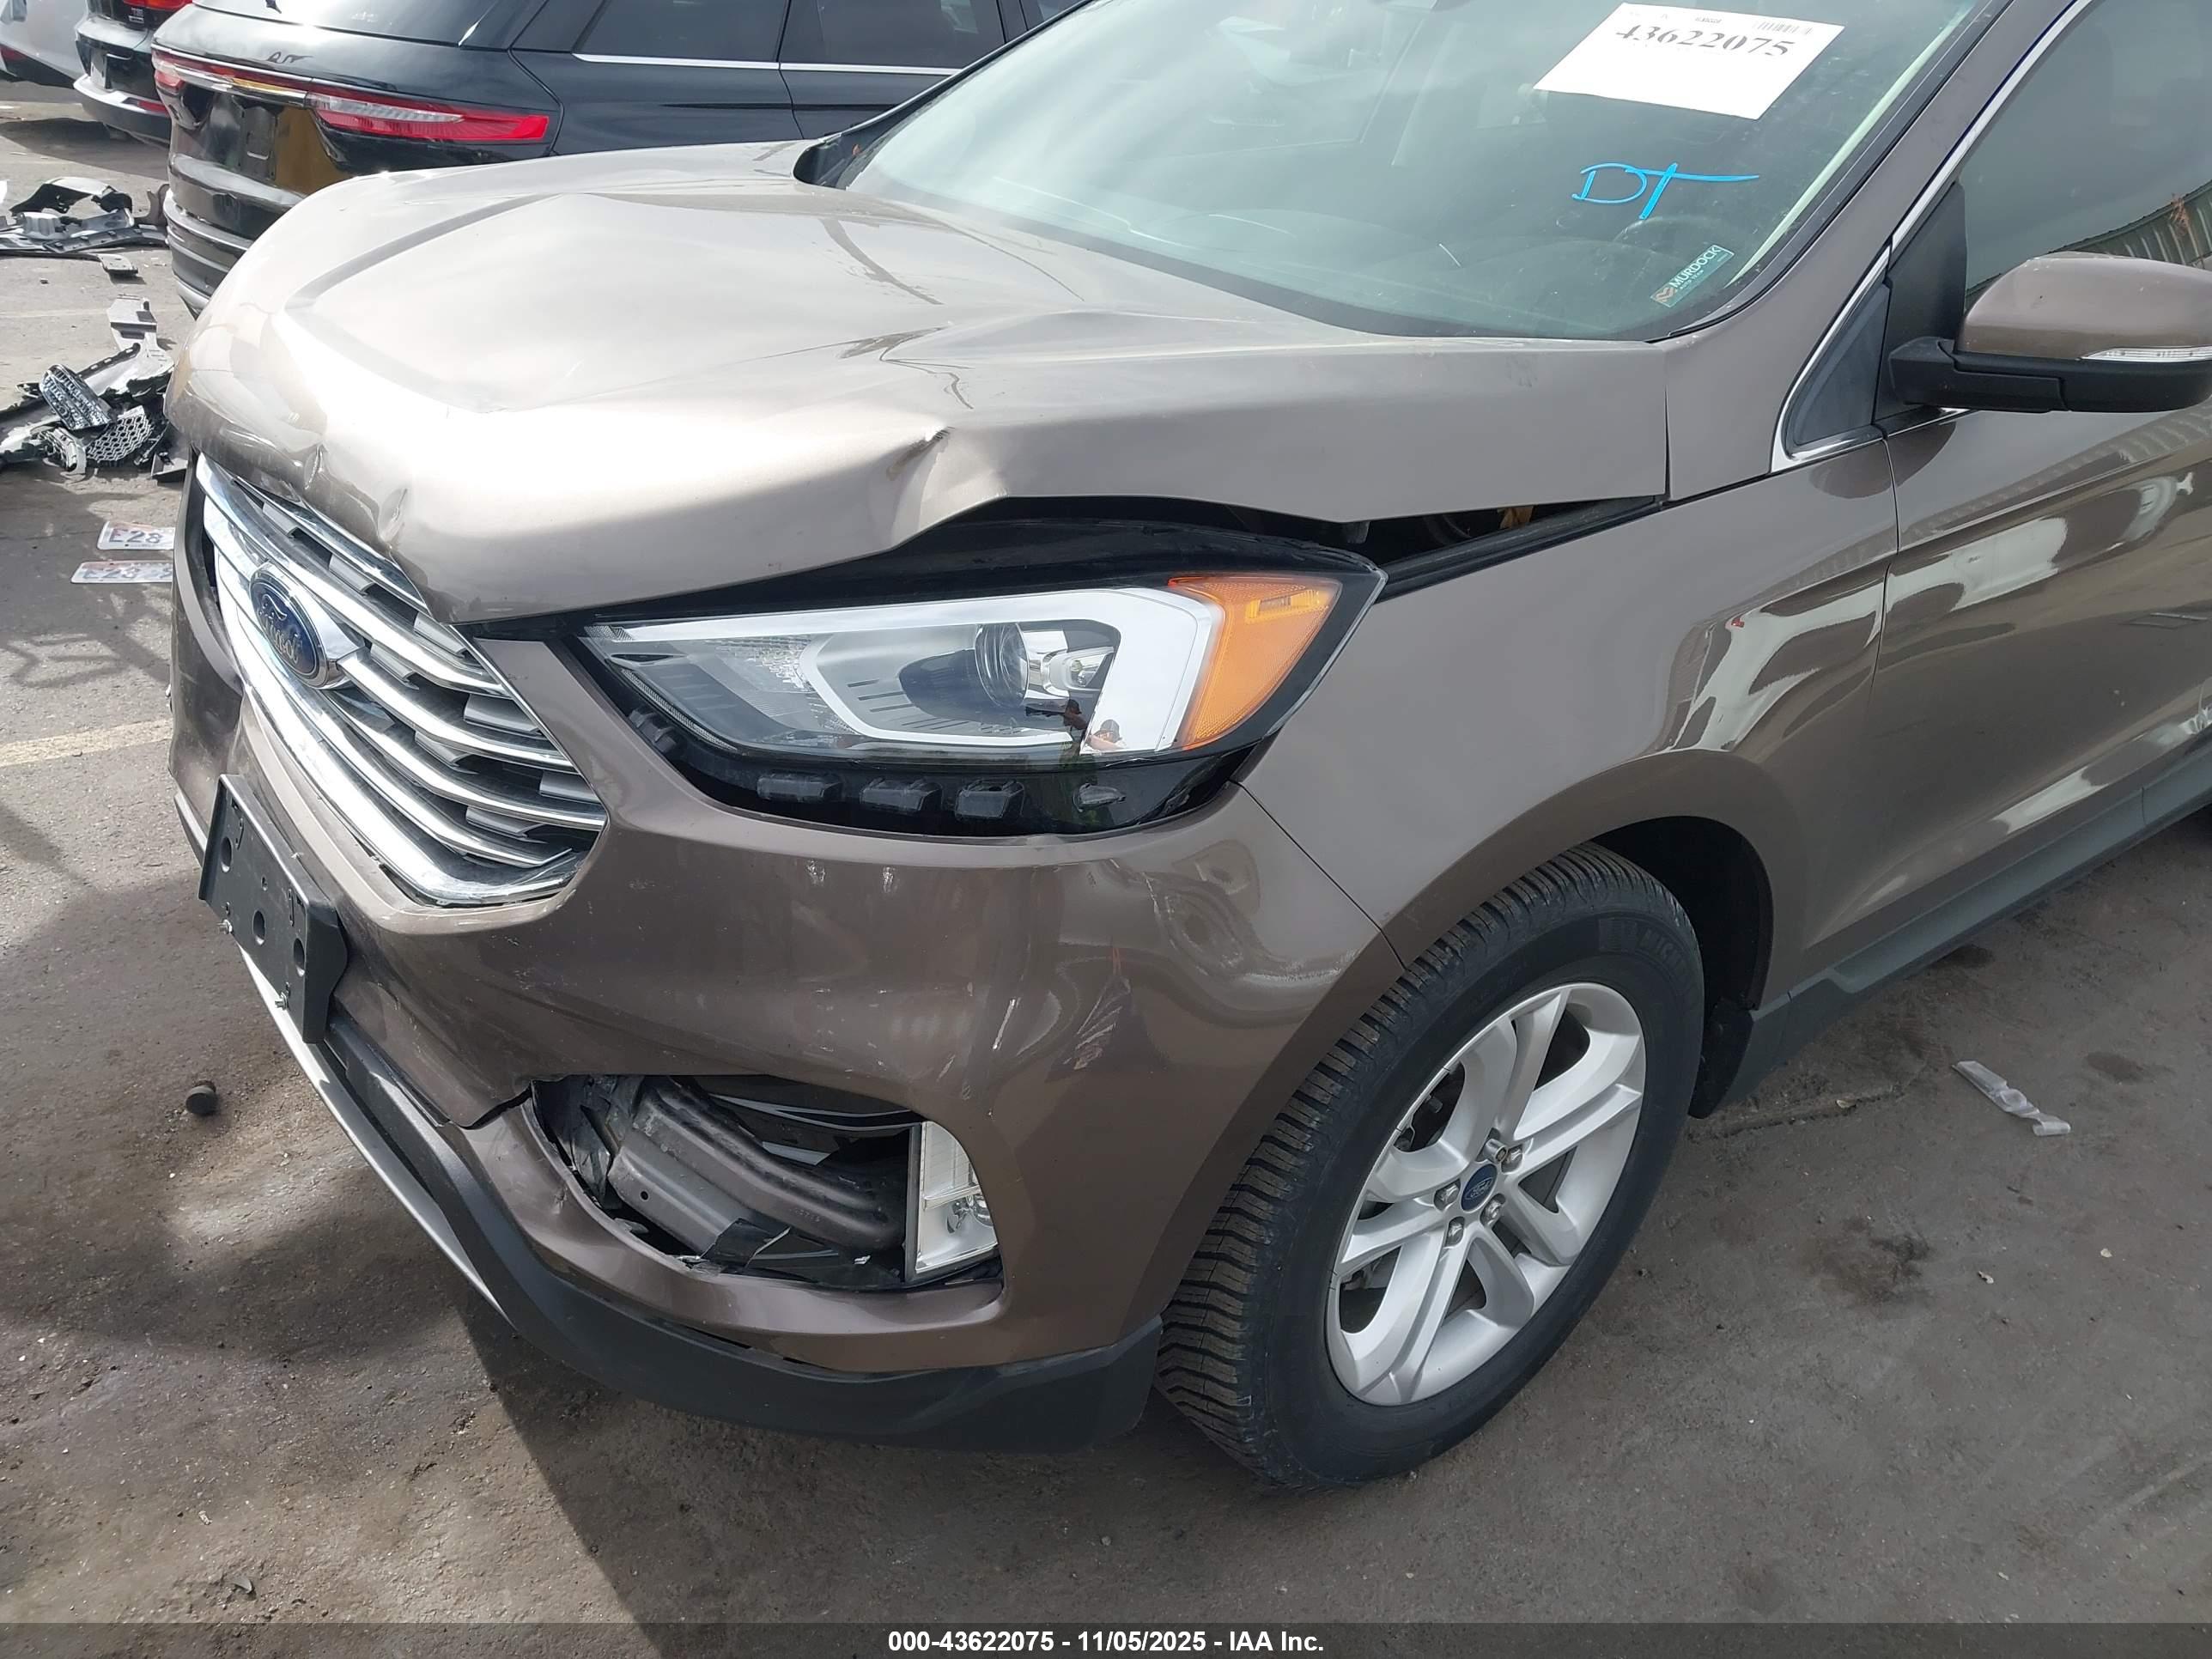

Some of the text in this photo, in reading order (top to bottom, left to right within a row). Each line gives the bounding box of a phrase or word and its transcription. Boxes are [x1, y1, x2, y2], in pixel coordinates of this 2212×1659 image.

[1615, 23, 1796, 57] 43622075
[1571, 162, 1759, 221] DT
[1668, 246, 1722, 289] MURDOCK
[108, 527, 164, 544] E28
